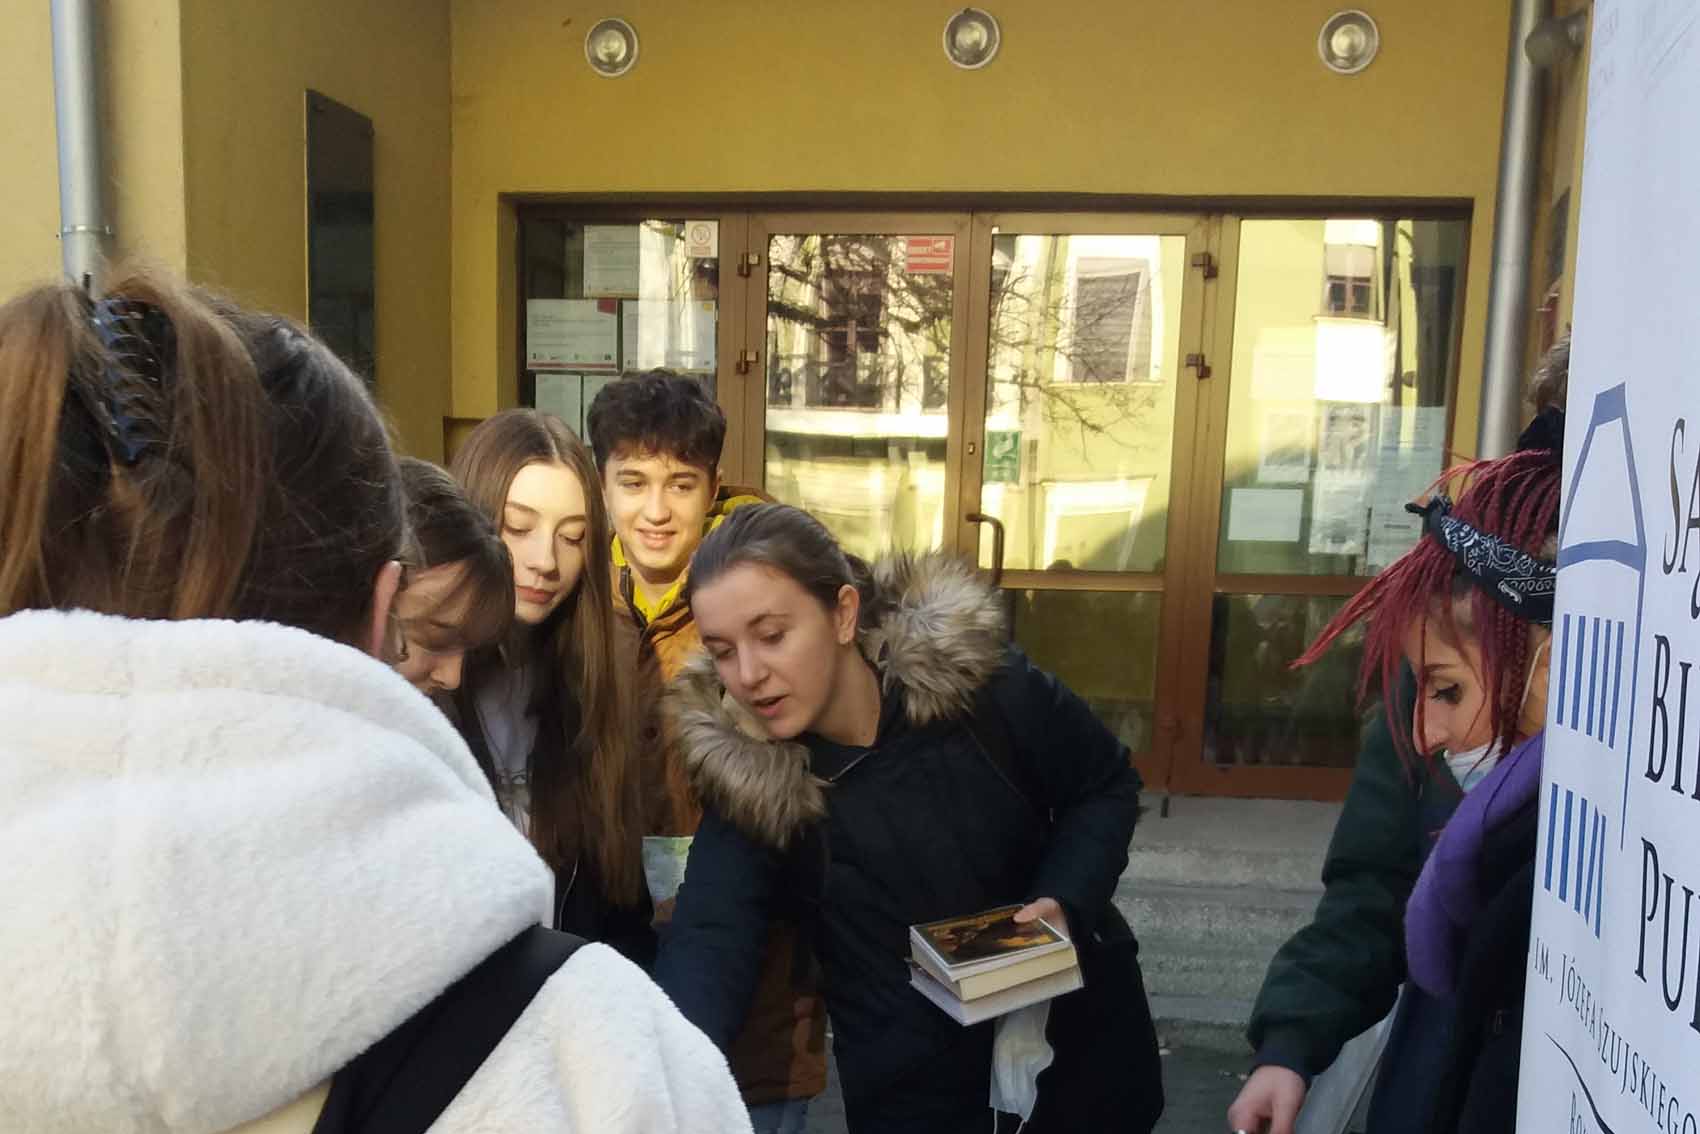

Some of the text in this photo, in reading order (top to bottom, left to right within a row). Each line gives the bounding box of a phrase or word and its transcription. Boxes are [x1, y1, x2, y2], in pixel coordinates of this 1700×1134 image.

[1644, 633, 1700, 802] BI
[1534, 936, 1553, 984] IM.
[1559, 953, 1597, 1040] JÓZEFA
[1635, 836, 1700, 1033] PU
